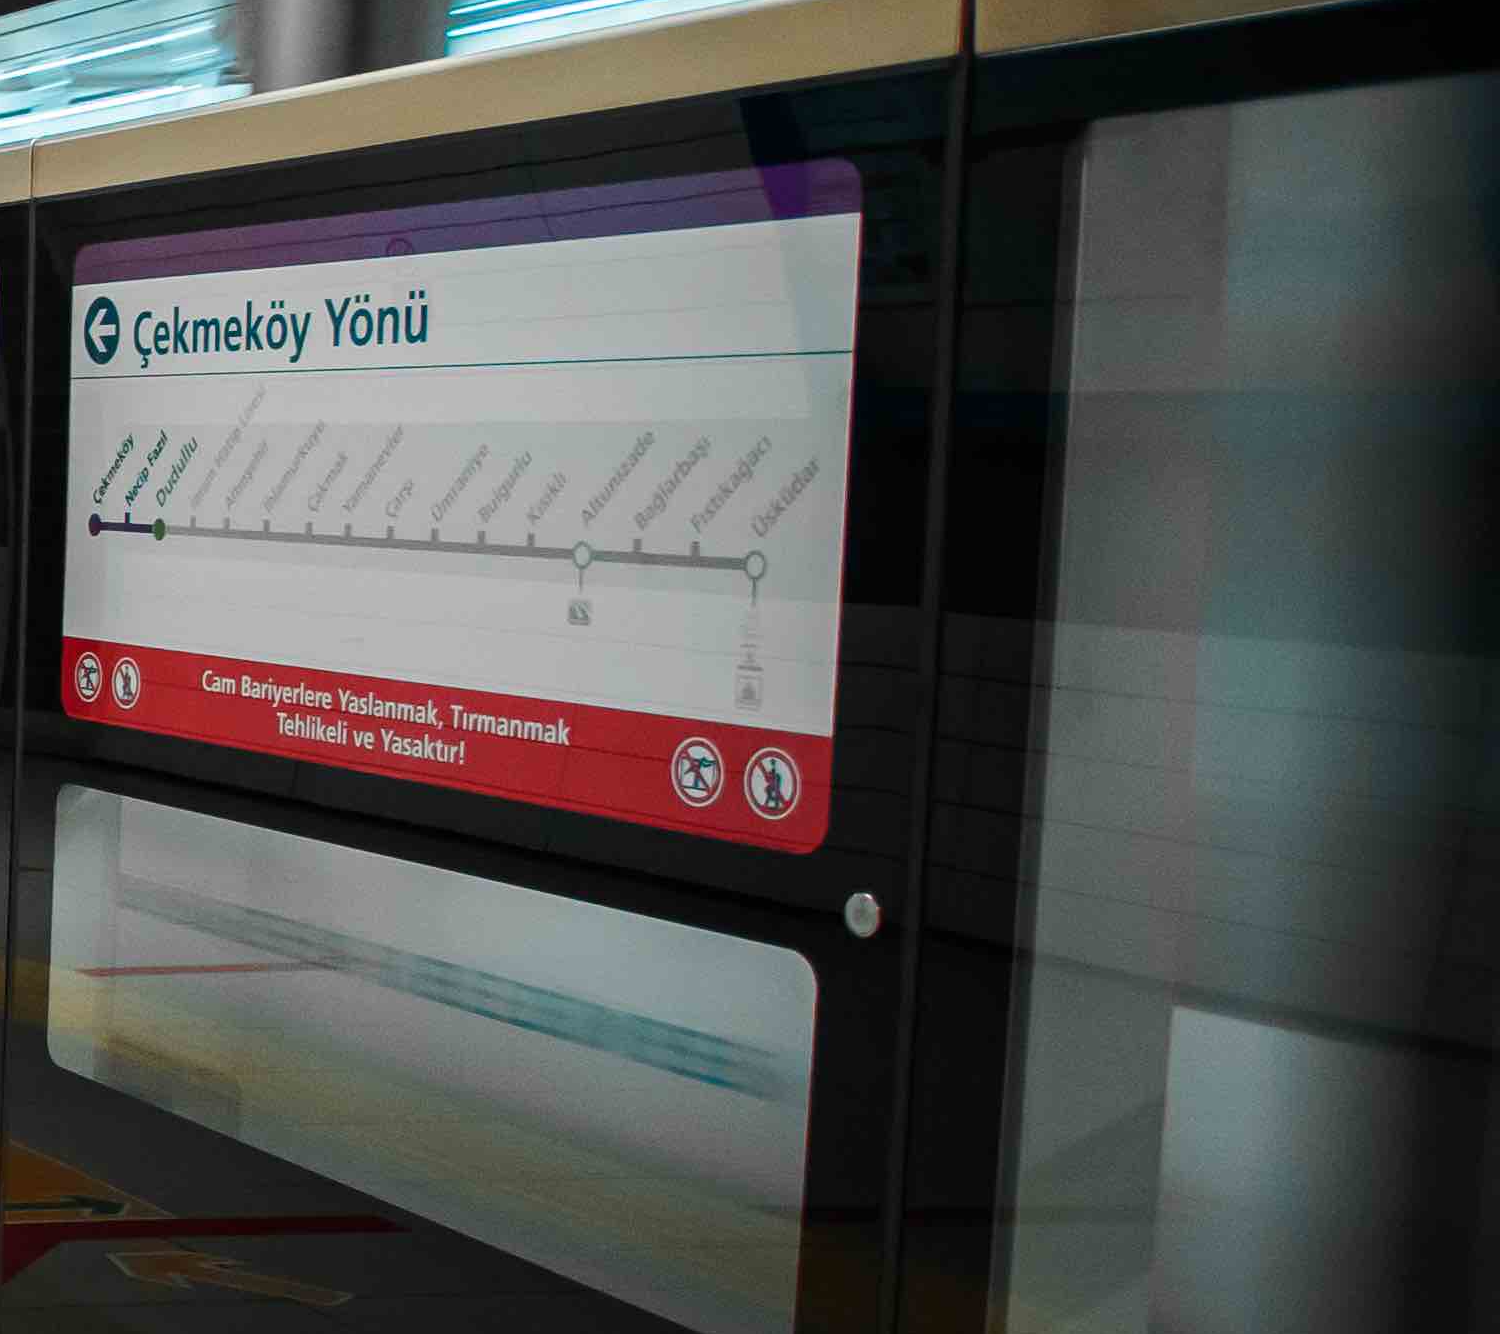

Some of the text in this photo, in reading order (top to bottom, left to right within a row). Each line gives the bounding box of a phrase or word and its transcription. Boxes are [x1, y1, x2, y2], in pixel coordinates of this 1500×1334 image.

[134, 290, 428, 368] Çekmeköy Yönü
[125, 428, 168, 506] Necip Fazıl
[156, 436, 199, 507] Dudullu
[750, 456, 820, 539] Üsküdar
[202, 670, 570, 746] Cam Bariyerlere Yaslanmak, Tırmanmak
[277, 712, 465, 765] Tehlikeli ve Yasaktır!
